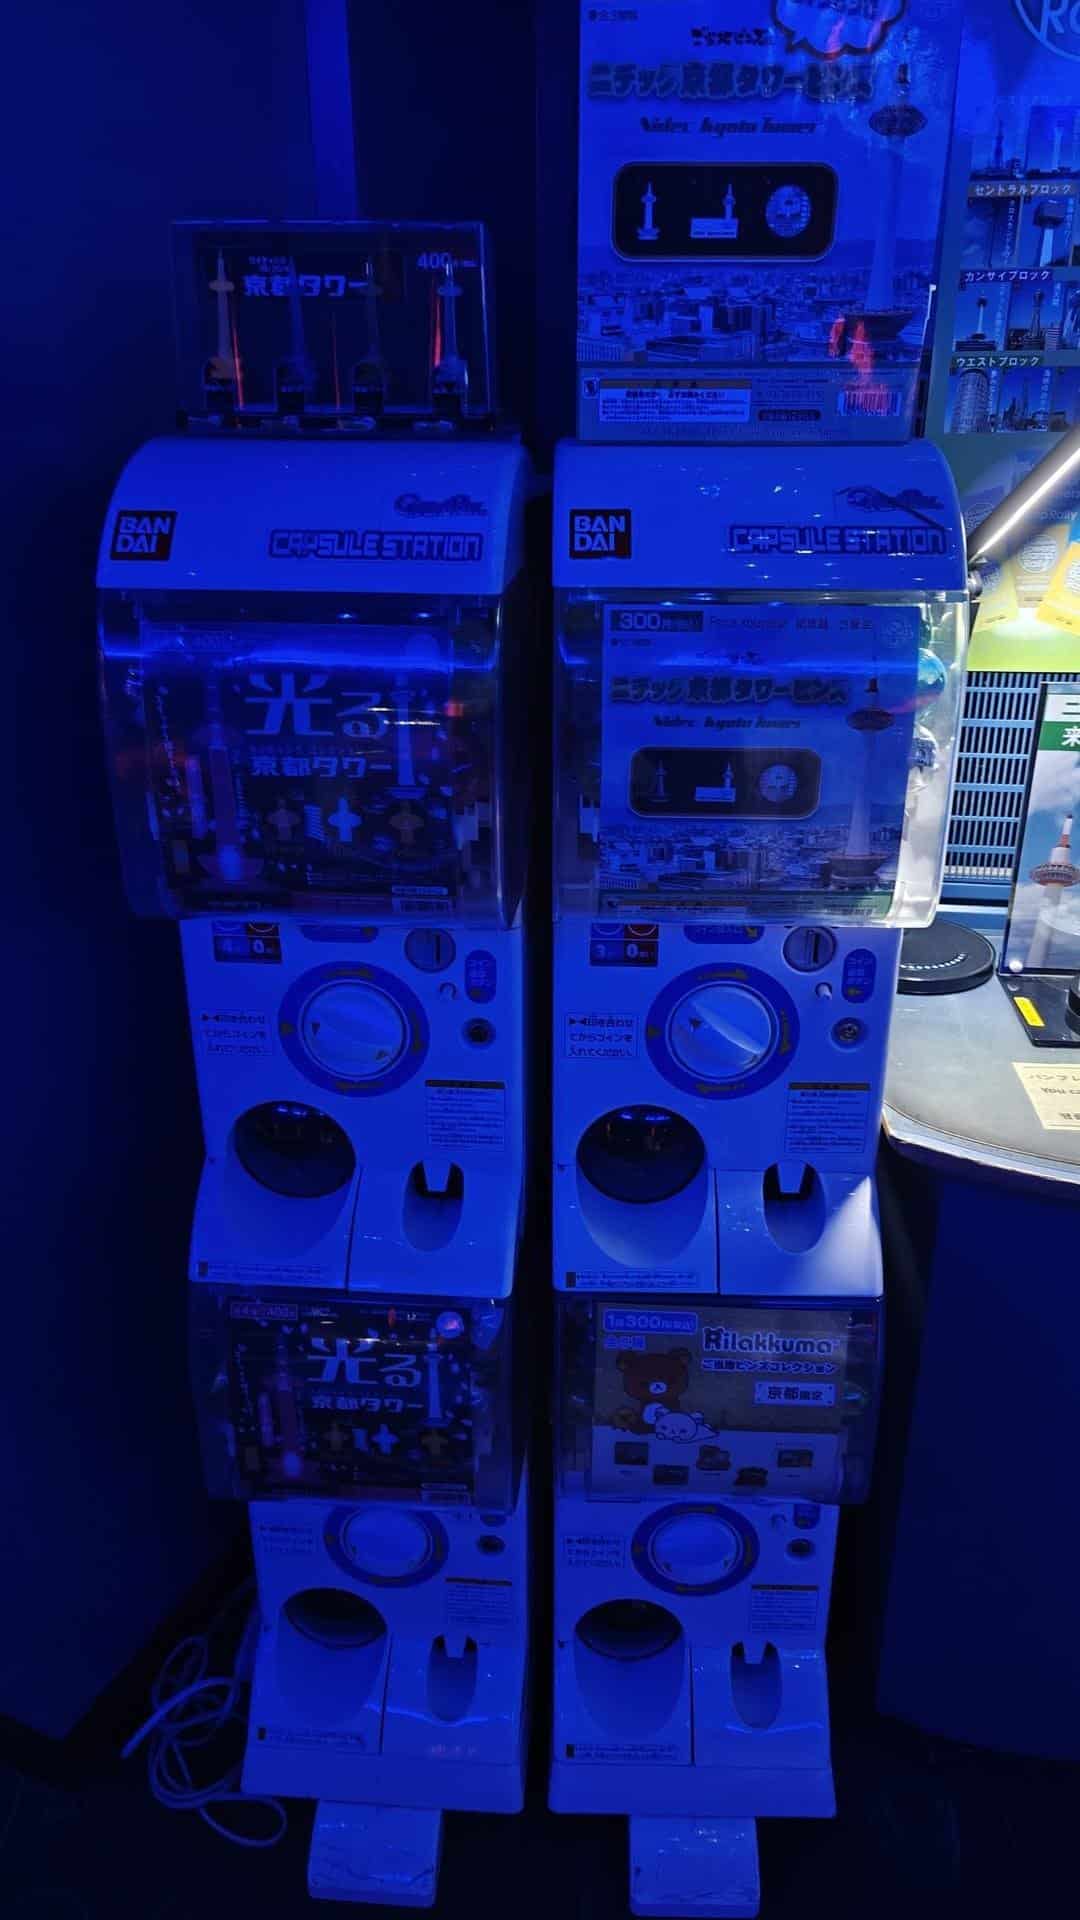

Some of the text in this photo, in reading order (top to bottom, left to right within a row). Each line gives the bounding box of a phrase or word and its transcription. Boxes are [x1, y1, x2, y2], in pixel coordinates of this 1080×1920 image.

[975, 184, 1072, 197] セントラルブロック
[964, 271, 1050, 282] カンサイブロック
[956, 356, 1040, 368] ウエストブロック
[119, 517, 171, 534] BAN
[574, 515, 626, 532] BAN
[116, 535, 158, 553] DAI
[270, 532, 481, 560] CAPSULE STATION
[573, 534, 617, 551] DAI
[729, 527, 947, 554] CAPSULE STATION
[244, 671, 389, 738] 光る
[252, 756, 392, 778] 京都タワー
[702, 1328, 834, 1354] Rilakkuma
[306, 1338, 423, 1388] 光る
[311, 1396, 425, 1412] 京都タワー
